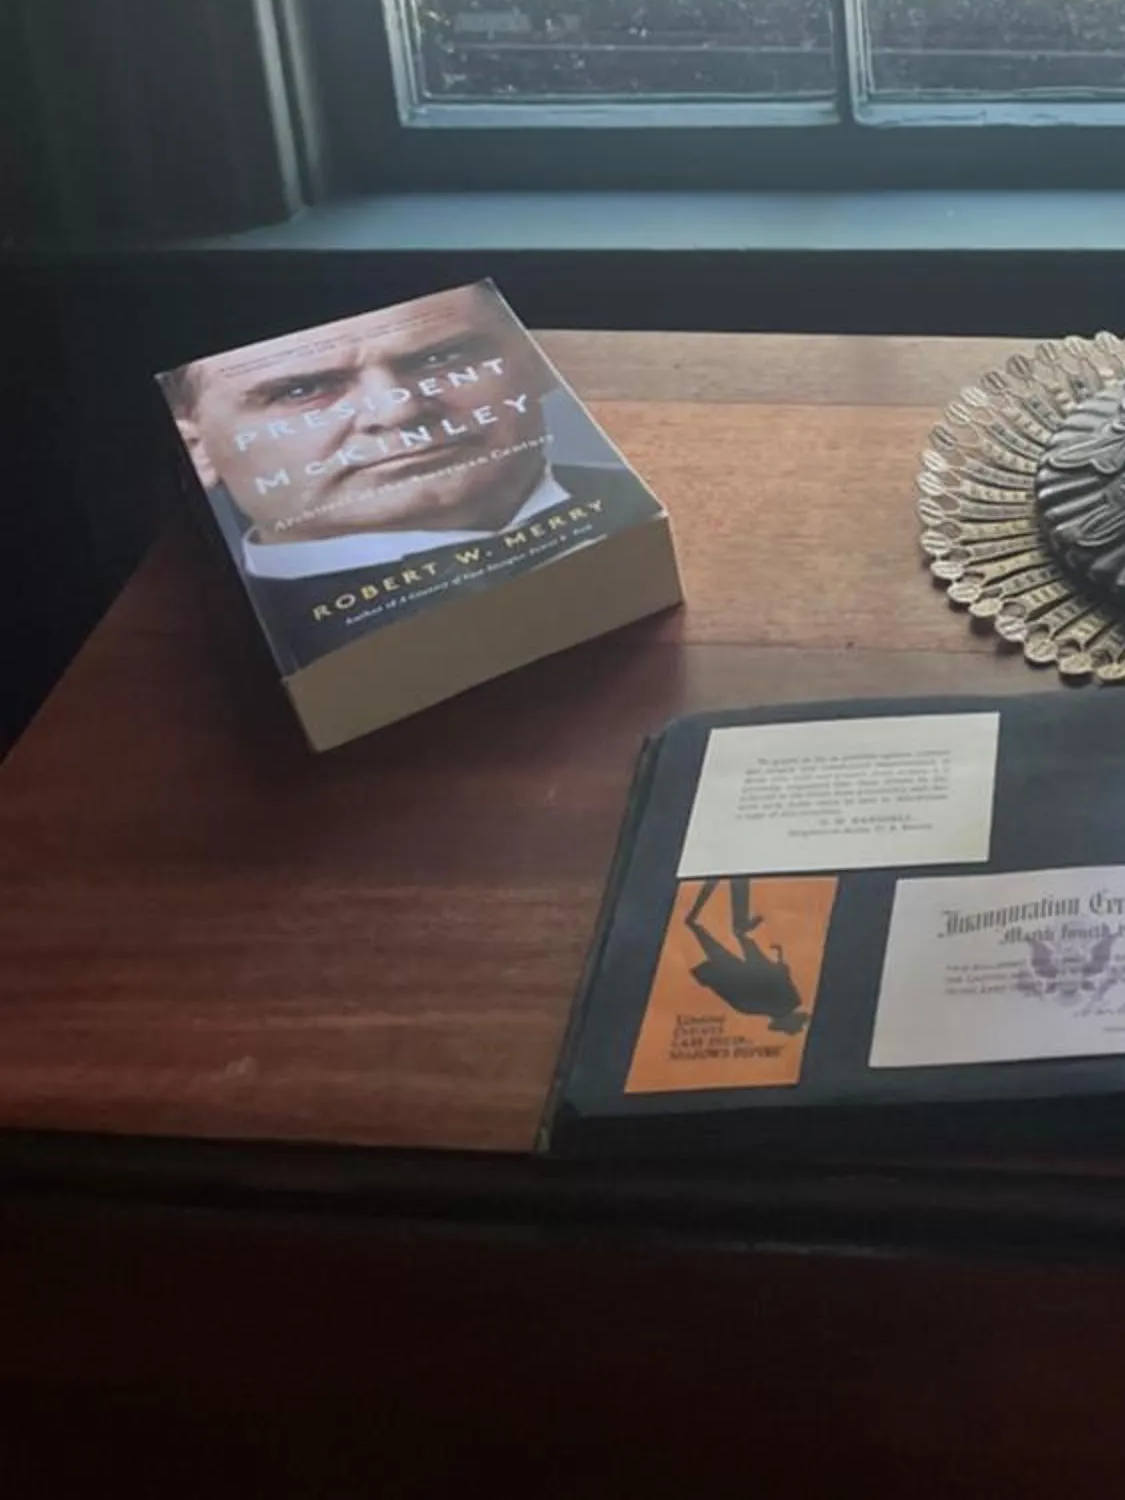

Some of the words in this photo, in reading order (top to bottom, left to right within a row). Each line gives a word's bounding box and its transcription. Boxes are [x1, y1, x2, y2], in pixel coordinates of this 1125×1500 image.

[235, 358, 503, 450] PRESIDENT
[312, 561, 437, 621] ROBERT
[455, 548, 492, 565] W.
[504, 499, 603, 548] MERRY
[937, 894, 1080, 938] Inauguration
